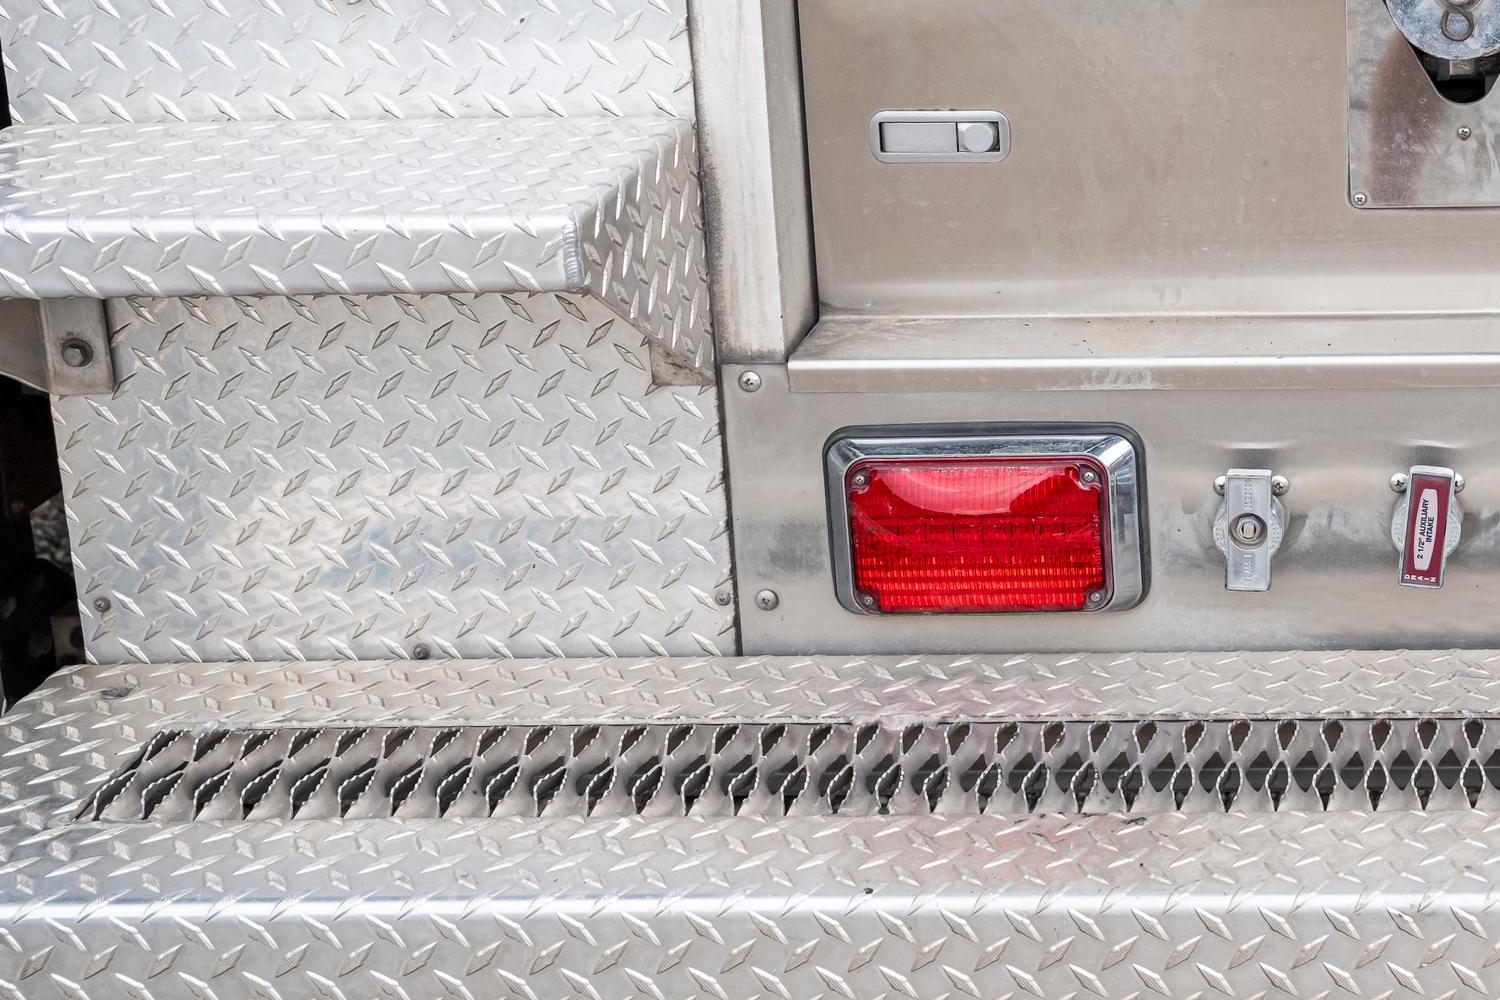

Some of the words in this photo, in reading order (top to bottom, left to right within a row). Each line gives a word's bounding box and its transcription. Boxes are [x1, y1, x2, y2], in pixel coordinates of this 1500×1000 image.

[1419, 498, 1430, 537] AUXILIARY
[1426, 516, 1434, 542] INTAKE
[1404, 574, 1436, 582] DRAIN
